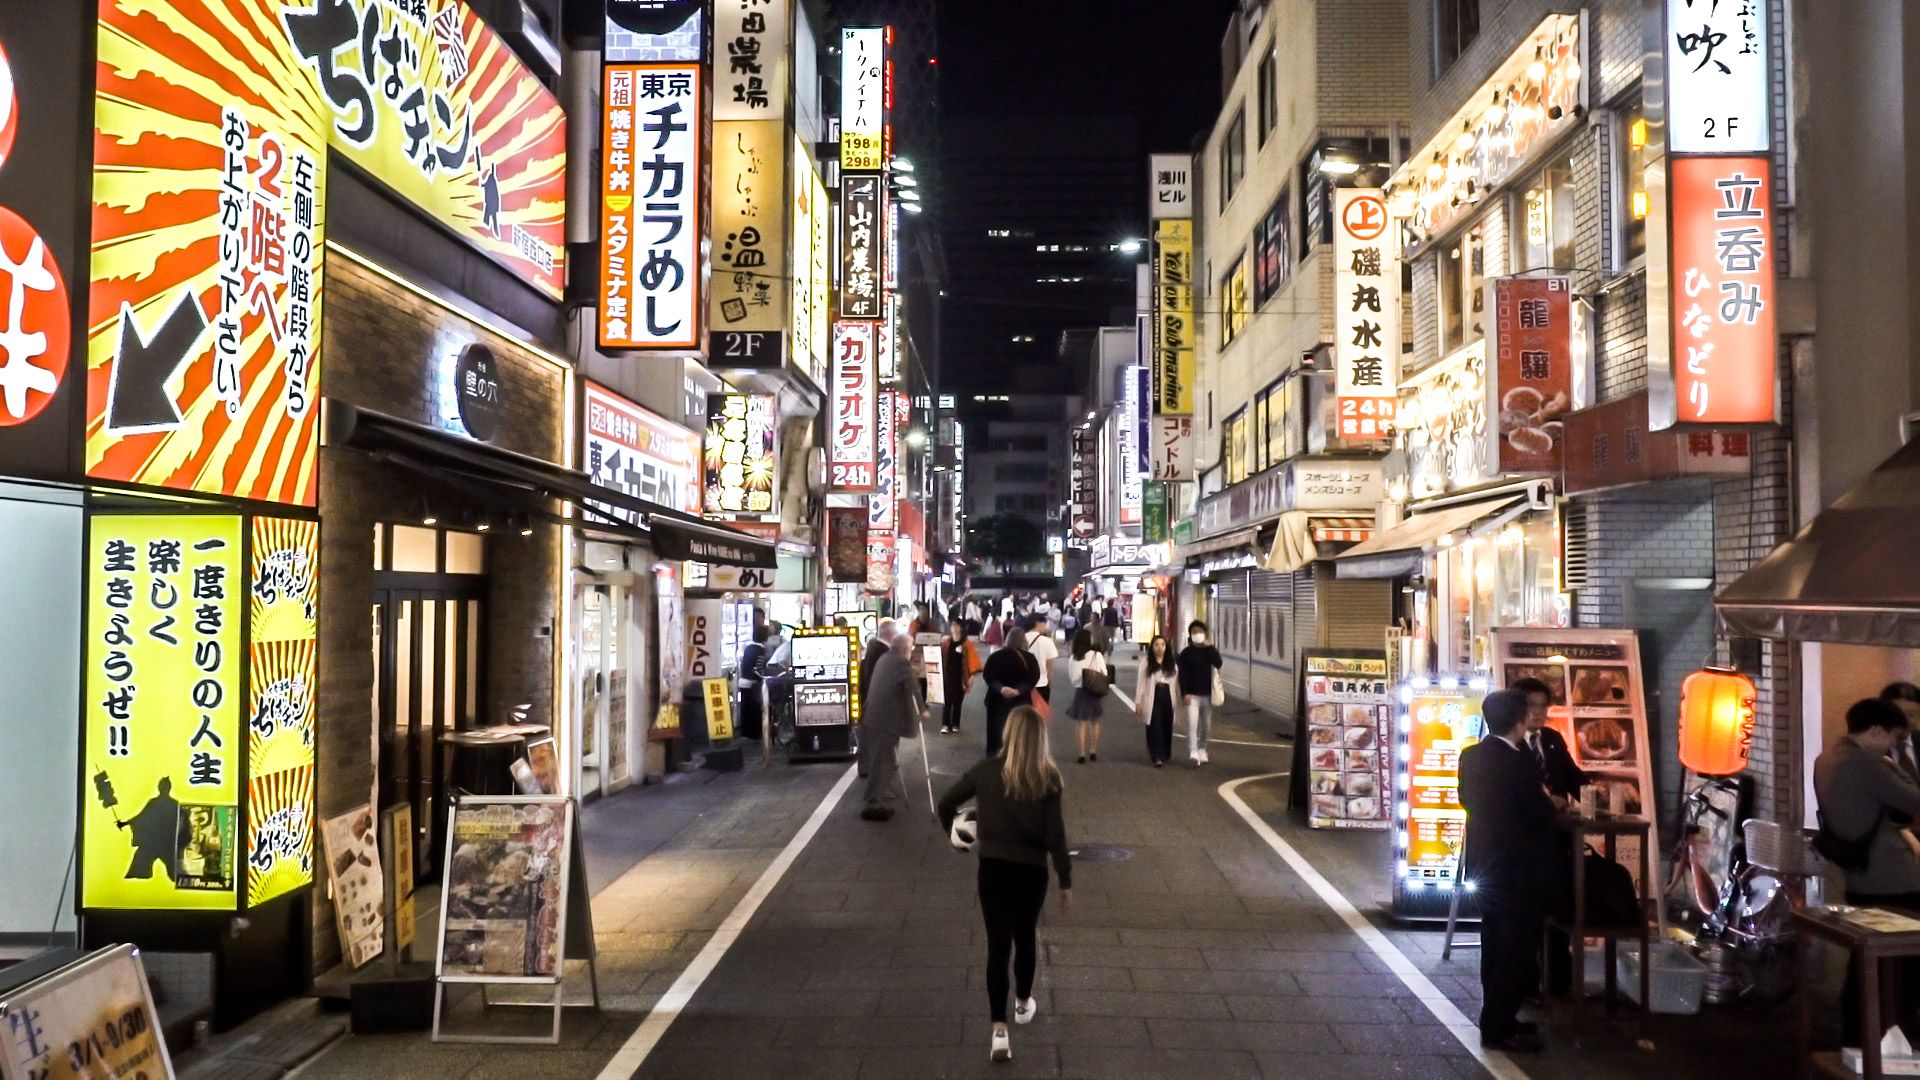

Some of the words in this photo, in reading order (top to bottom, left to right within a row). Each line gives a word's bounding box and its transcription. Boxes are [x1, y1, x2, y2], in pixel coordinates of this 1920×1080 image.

[728, 0, 770, 109] 田農場
[1676, 0, 1731, 74] 吹
[1737, 0, 1758, 54] ぶしゃぶ
[613, 72, 629, 105] 元祖
[640, 73, 692, 98] 東京
[610, 109, 632, 191] 焼き牛丼
[737, 132, 763, 217] しゃぶしゃぶ
[640, 102, 688, 336] チカラめし
[1159, 190, 1186, 203] ビル
[216, 112, 245, 413] お上がり下さい。
[250, 139, 287, 342] 2階へ
[512, 227, 554, 272] 新宿西口店
[606, 215, 629, 340] スタミナ定食
[848, 202, 875, 298] 山内農場
[1715, 175, 1763, 324] 立呑み
[288, 154, 313, 413] 左側の階段から
[851, 302, 869, 314] 4F
[1350, 246, 1383, 387] 磯丸水産
[725, 332, 766, 357] 2F
[1165, 315, 1183, 410] Submarine
[1682, 269, 1713, 417] ひなどり
[840, 337, 865, 447] カラオケ
[1342, 400, 1393, 416] 24h
[833, 465, 871, 486] 24h
[1163, 417, 1180, 479] コンドル
[148, 539, 181, 645] 楽しく
[739, 568, 774, 588] めし
[189, 538, 226, 786] 一度きりの人生
[692, 615, 710, 677] DyDo
